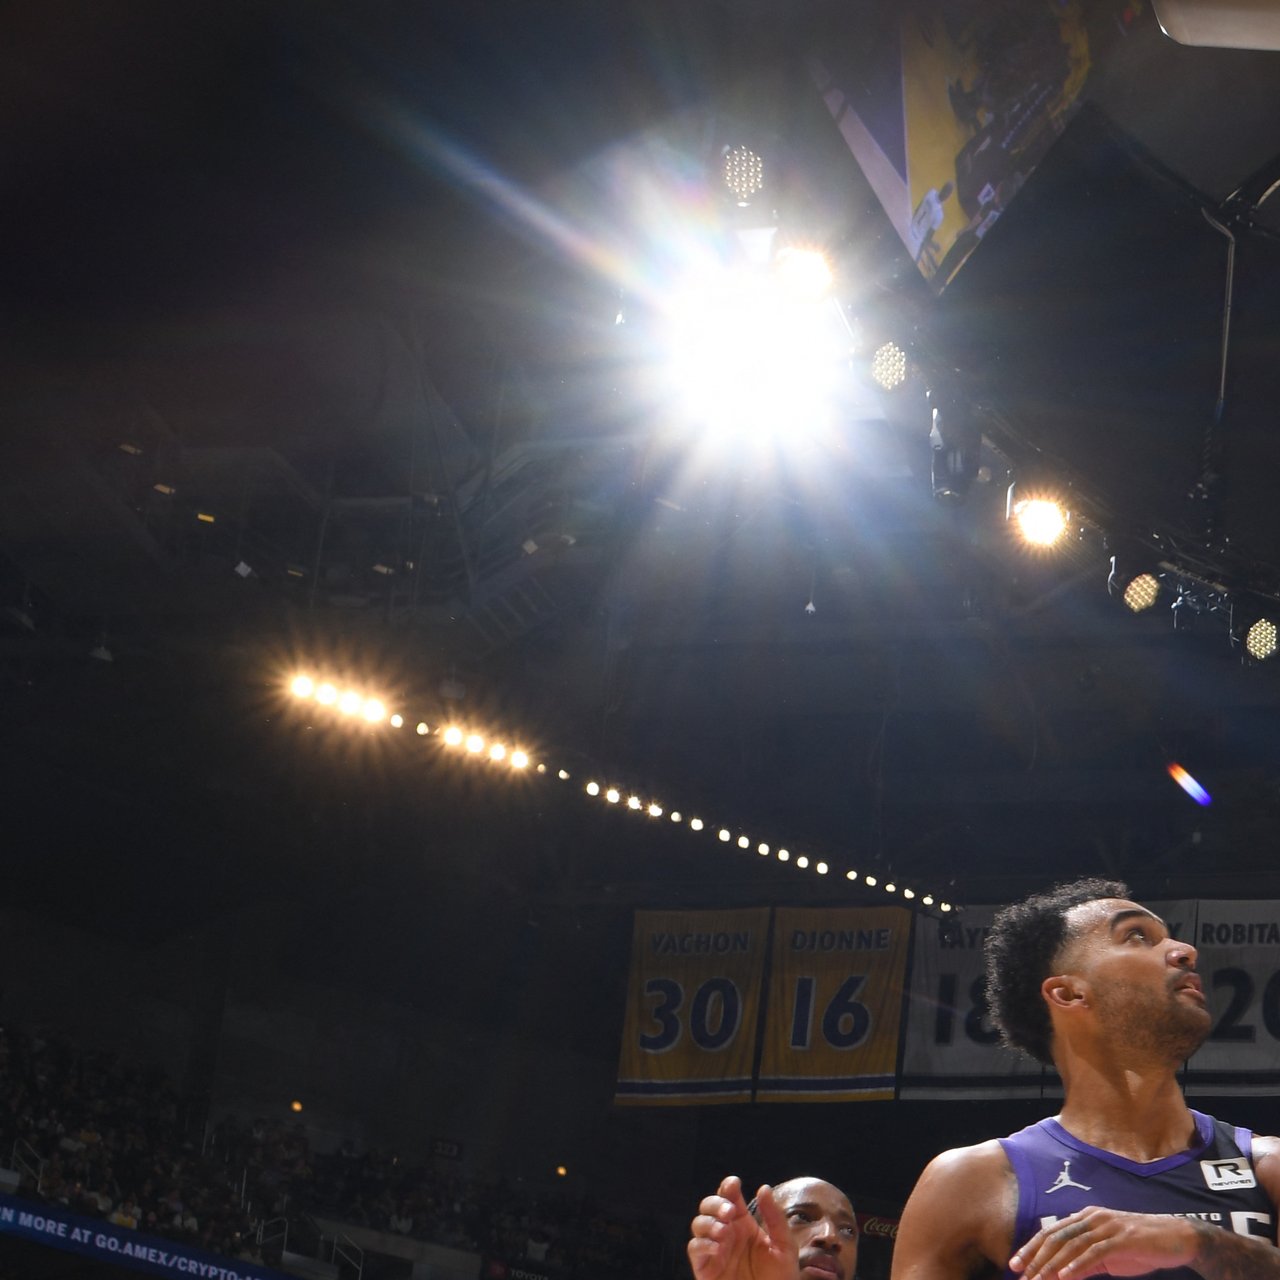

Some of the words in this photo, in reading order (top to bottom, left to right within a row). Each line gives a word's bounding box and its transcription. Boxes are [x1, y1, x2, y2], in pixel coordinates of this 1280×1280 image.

[652, 931, 750, 954] VACHON
[791, 928, 893, 952] DIONNE
[638, 976, 743, 1054] 30
[790, 975, 871, 1050] 16
[18, 1212, 67, 1238] MORE
[70, 1226, 90, 1244] AT
